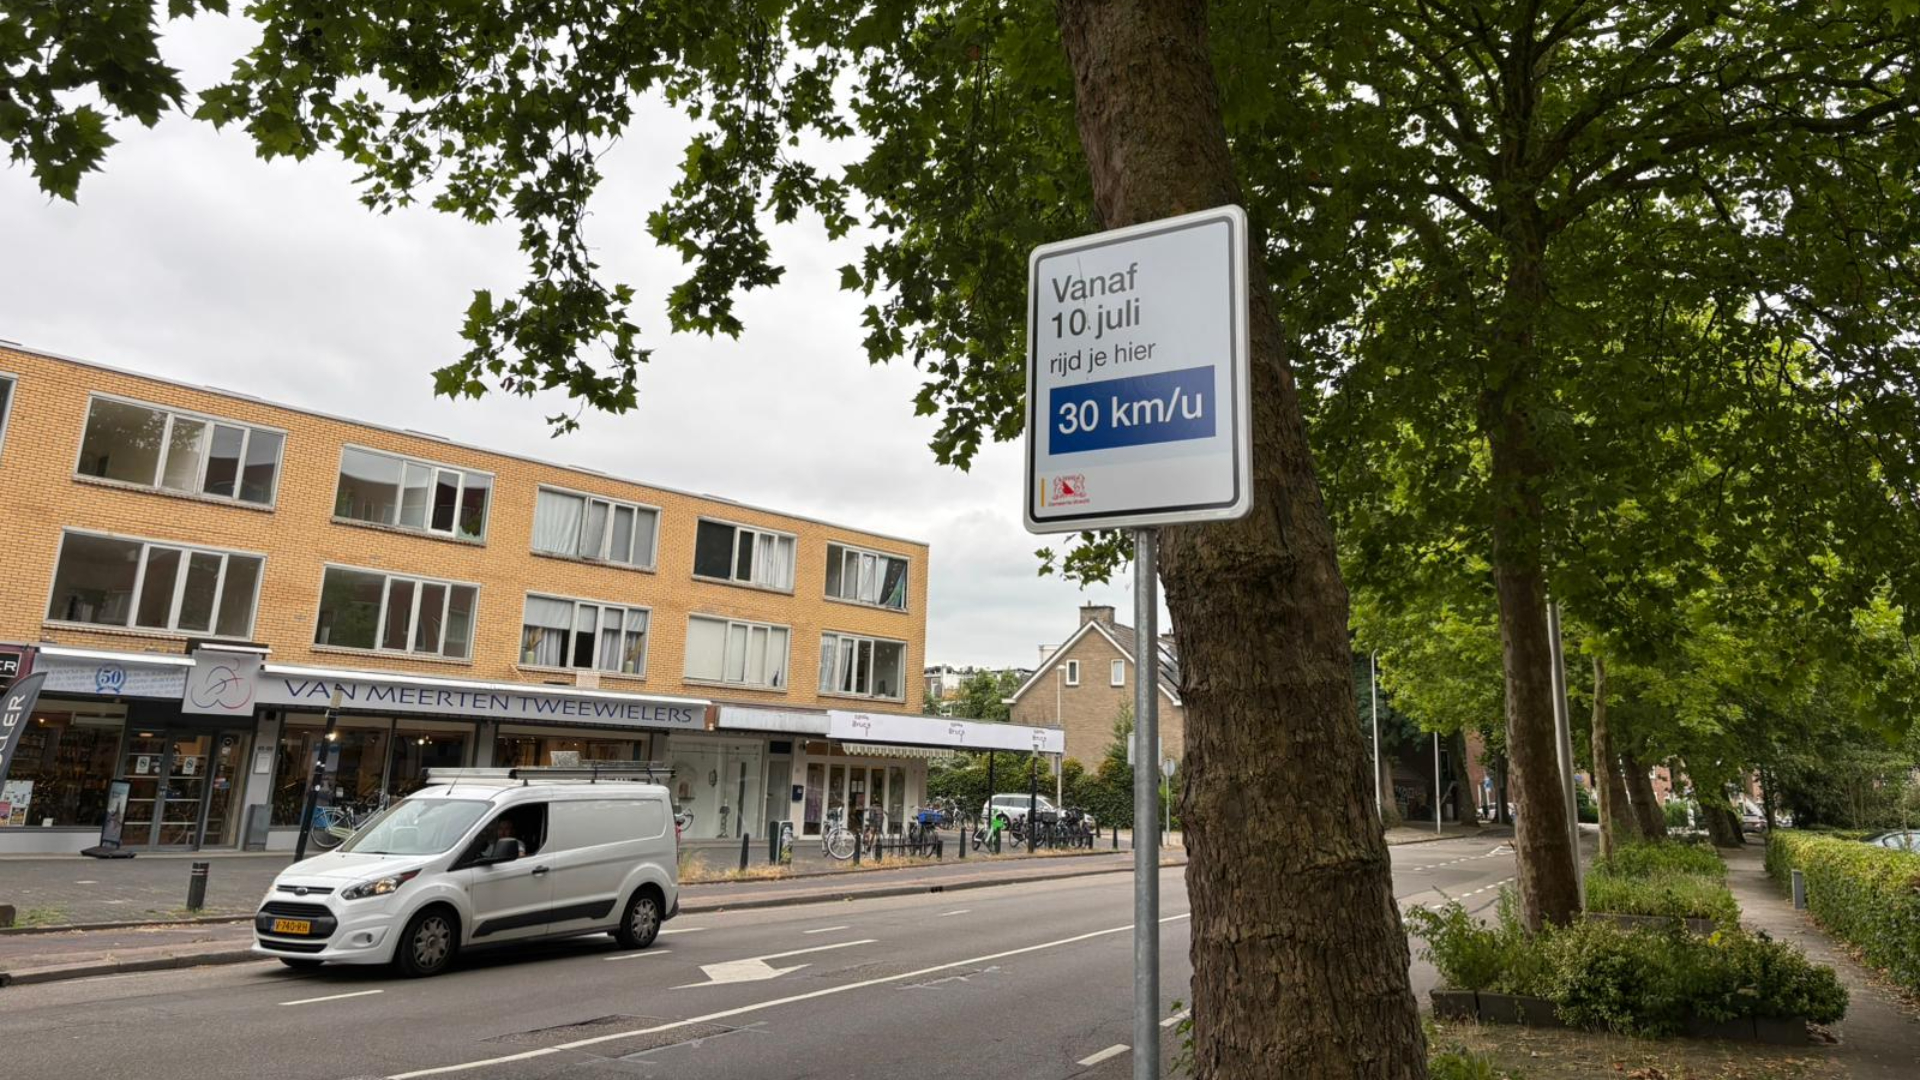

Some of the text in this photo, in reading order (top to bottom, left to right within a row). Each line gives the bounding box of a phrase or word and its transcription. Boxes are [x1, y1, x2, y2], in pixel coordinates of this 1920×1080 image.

[1051, 262, 1138, 304] Vanaf
[1051, 298, 1140, 340] 10 juli
[1050, 342, 1156, 377] rijd je hier
[1058, 387, 1203, 435] 30 km/u
[101, 670, 122, 685] 50
[284, 679, 693, 723] VAN MEERTEN TWEEWIELERS
